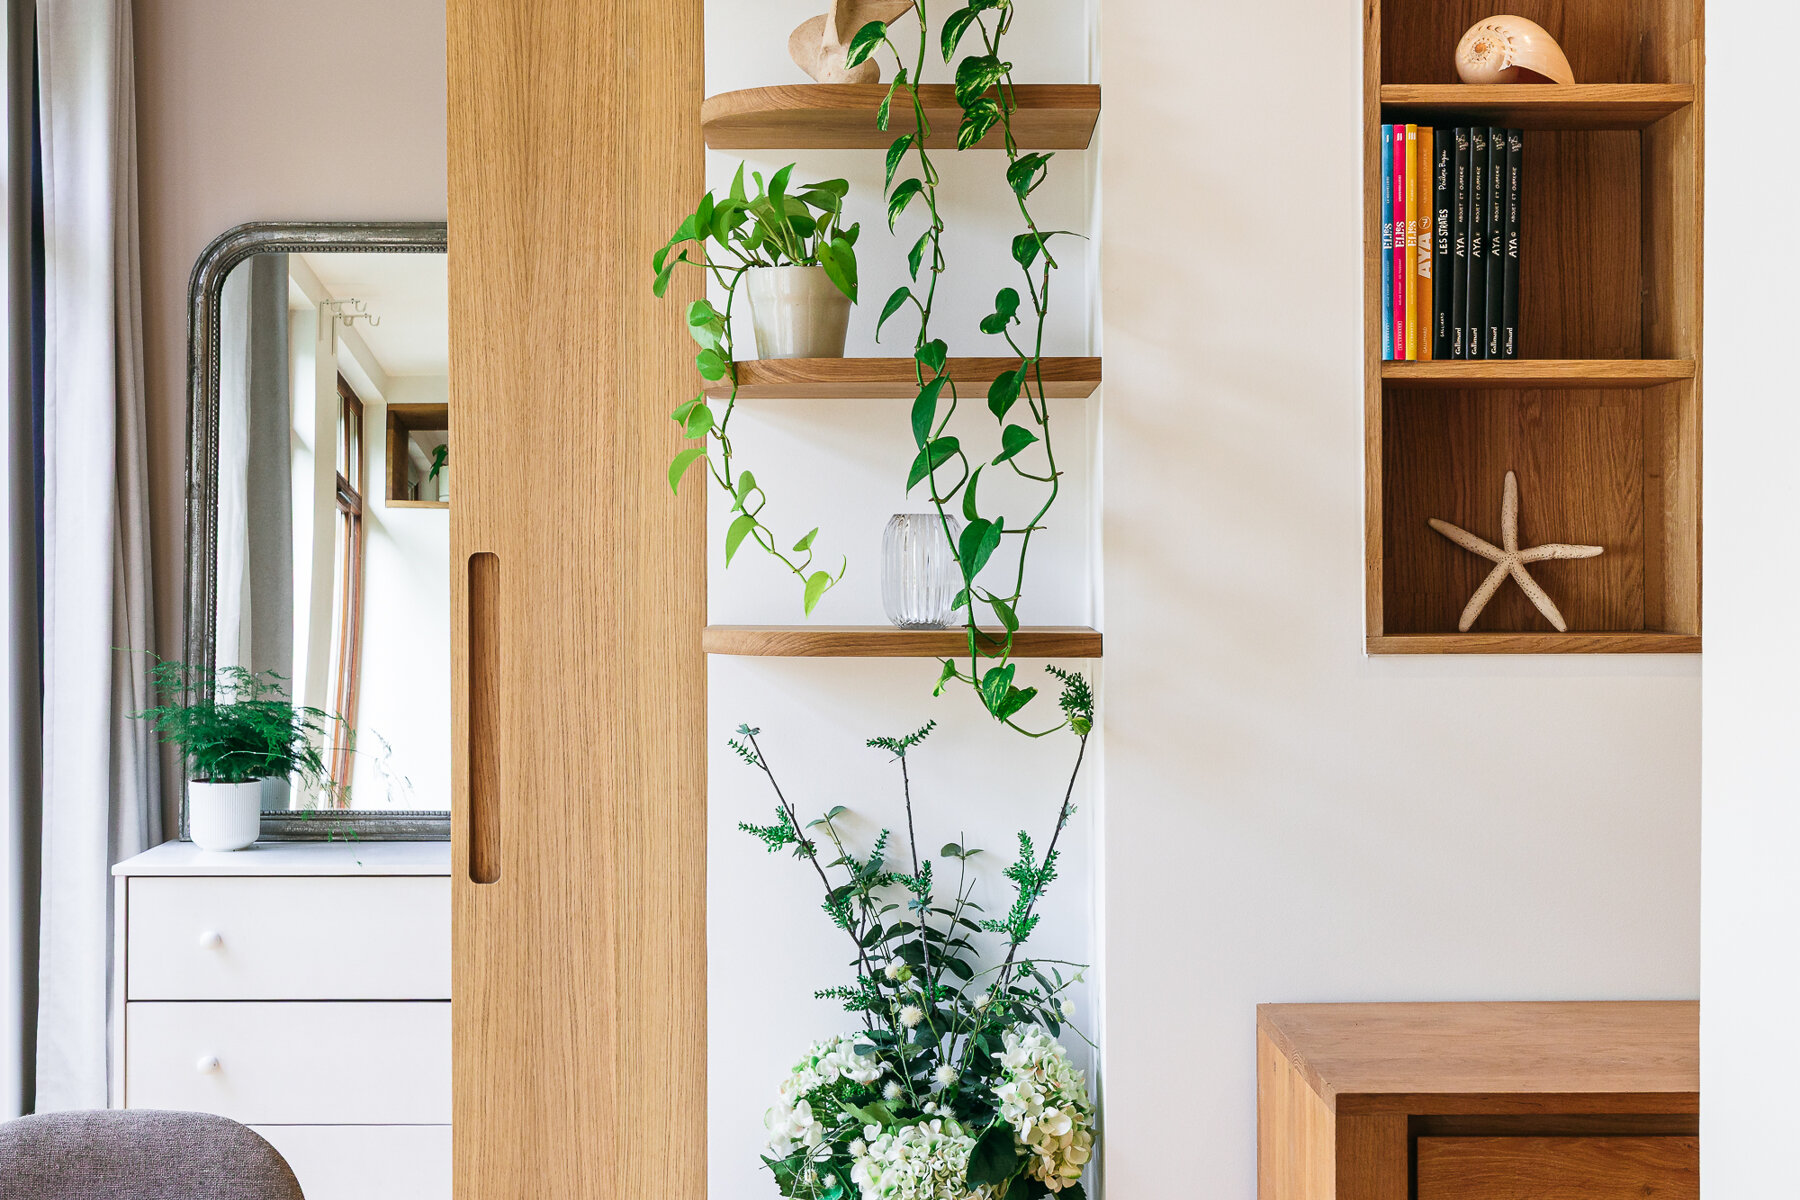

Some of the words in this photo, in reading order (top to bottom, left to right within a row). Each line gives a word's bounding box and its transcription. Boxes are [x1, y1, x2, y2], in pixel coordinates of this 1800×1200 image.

[1438, 209, 1448, 236] STRATES
[1418, 232, 1431, 279] AYA
[1439, 238, 1448, 254] LES
[1456, 238, 1464, 257] AYA
[1473, 238, 1481, 257] AYA
[1492, 236, 1500, 256] AYA
[1509, 238, 1517, 258] AYA
